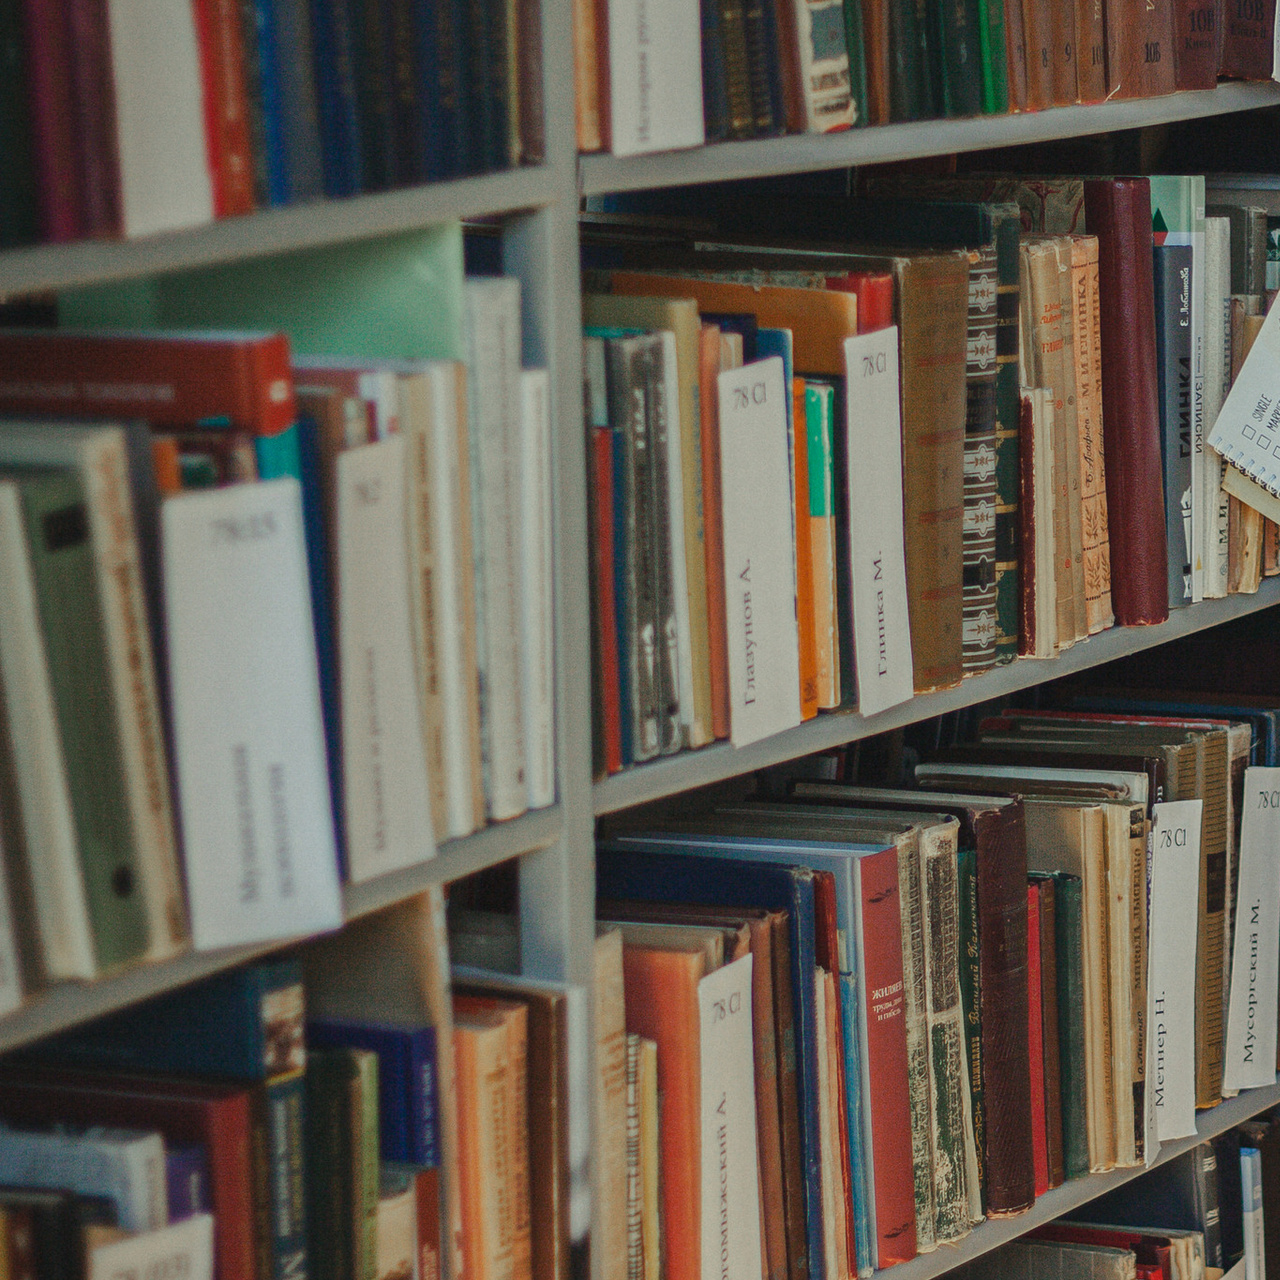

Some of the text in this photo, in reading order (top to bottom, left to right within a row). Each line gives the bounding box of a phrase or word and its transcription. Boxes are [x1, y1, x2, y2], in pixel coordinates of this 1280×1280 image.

[1041, 47, 1049, 69] 8
[1064, 42, 1072, 63] 9
[635, 51, 651, 144] История
[863, 355, 875, 377] 78
[1077, 274, 1094, 469] Асафьев ГЛИНКА
[733, 386, 749, 410] 78
[1251, 392, 1273, 423] SINGLE
[1195, 381, 1203, 454] ЗАПИСКИ
[871, 549, 888, 678] Глинка М.
[738, 558, 758, 707] Глазунов А.
[1256, 789, 1268, 811] 78
[1160, 829, 1174, 849] 78
[966, 874, 982, 1026] Василий Калинников
[1242, 898, 1261, 1064] Мусоргский М.
[712, 998, 726, 1023] 78
[1154, 990, 1167, 1109] Метнер Н.
[714, 1090, 728, 1117] А.
